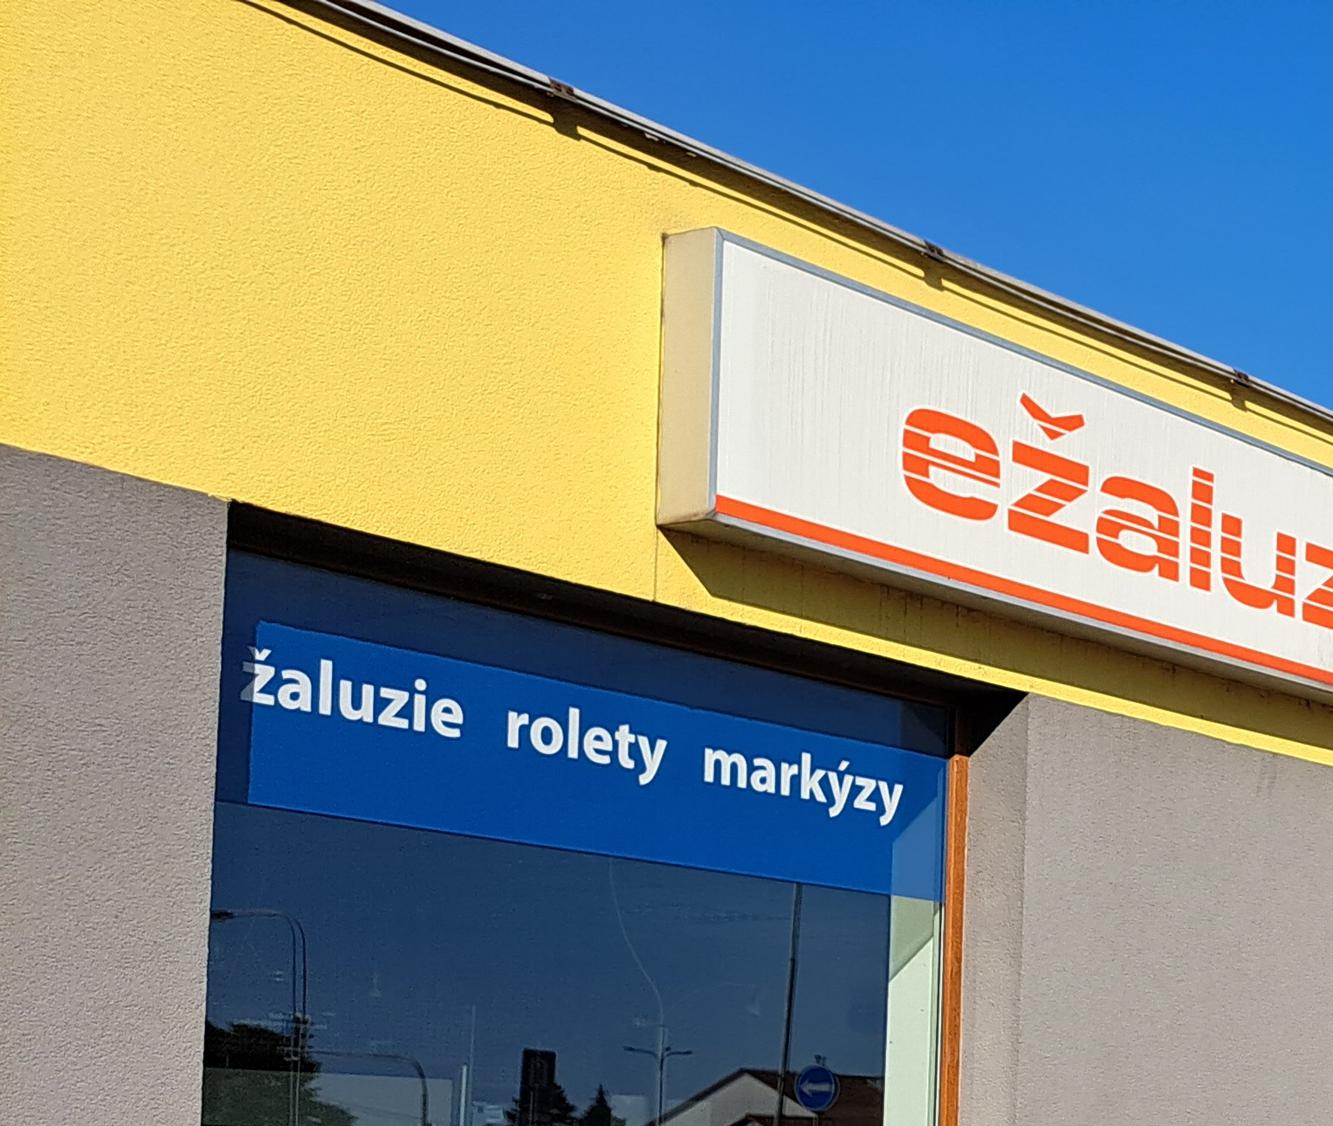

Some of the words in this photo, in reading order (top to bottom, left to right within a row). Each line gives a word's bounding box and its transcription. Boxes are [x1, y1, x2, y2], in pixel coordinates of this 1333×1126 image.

[240, 646, 464, 739] žaluzie
[505, 706, 667, 784] rolety
[703, 743, 904, 826] markýzy
